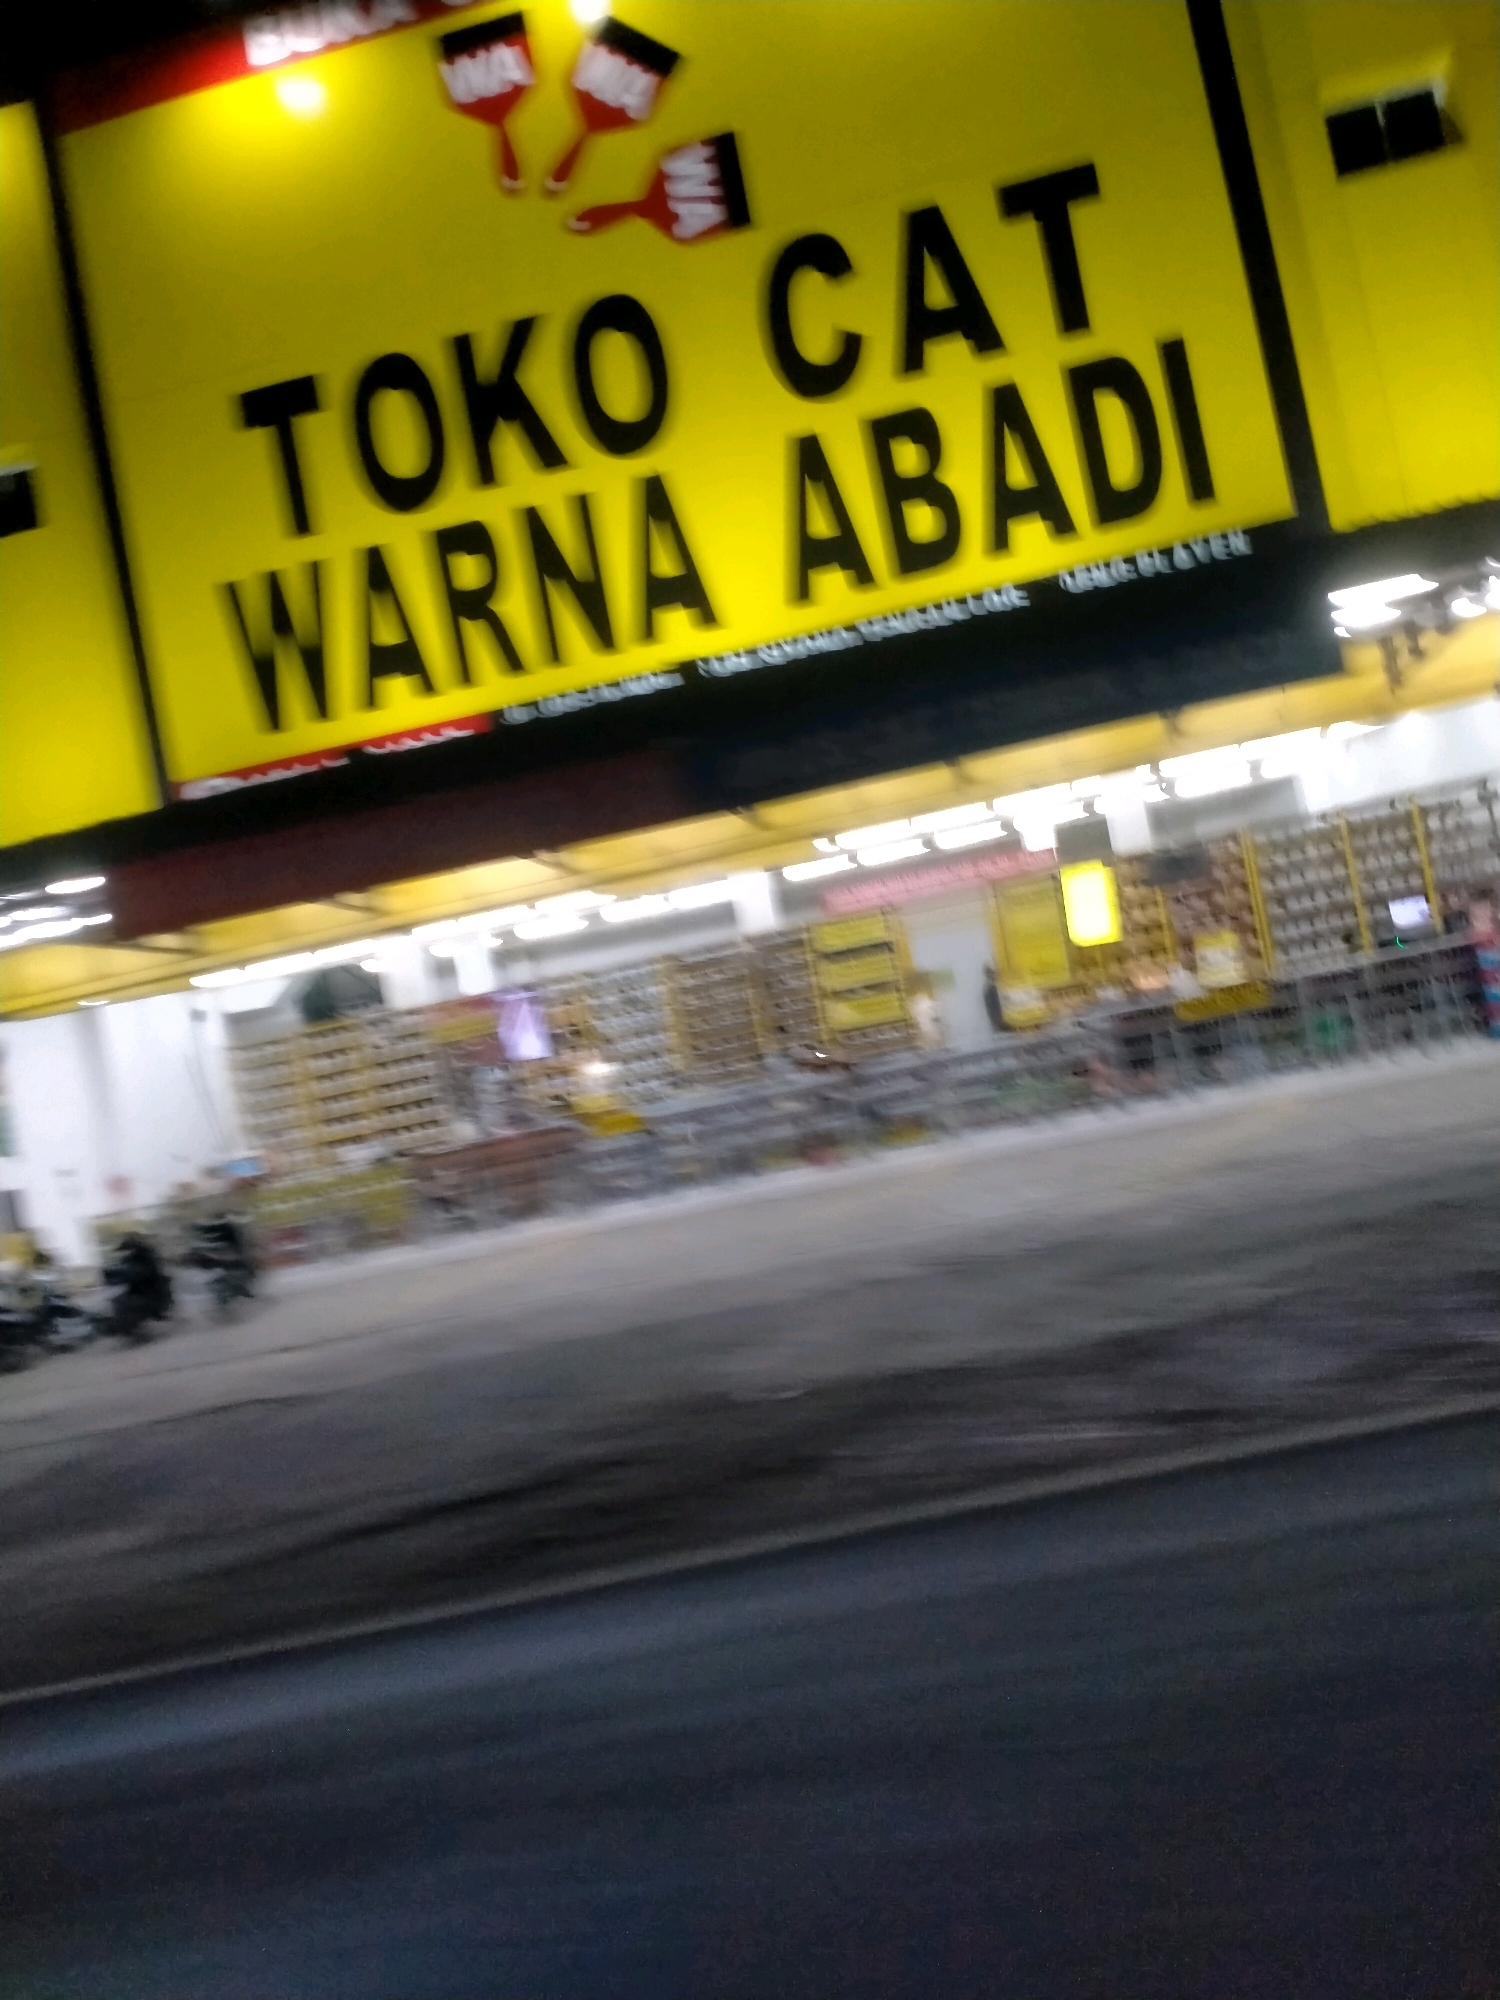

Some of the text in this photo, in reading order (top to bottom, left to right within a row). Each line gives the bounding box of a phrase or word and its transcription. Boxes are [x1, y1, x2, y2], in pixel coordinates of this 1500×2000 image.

[222, 336, 1218, 733] WARNA ABADI
[232, 158, 1102, 538] TOKO CAT
